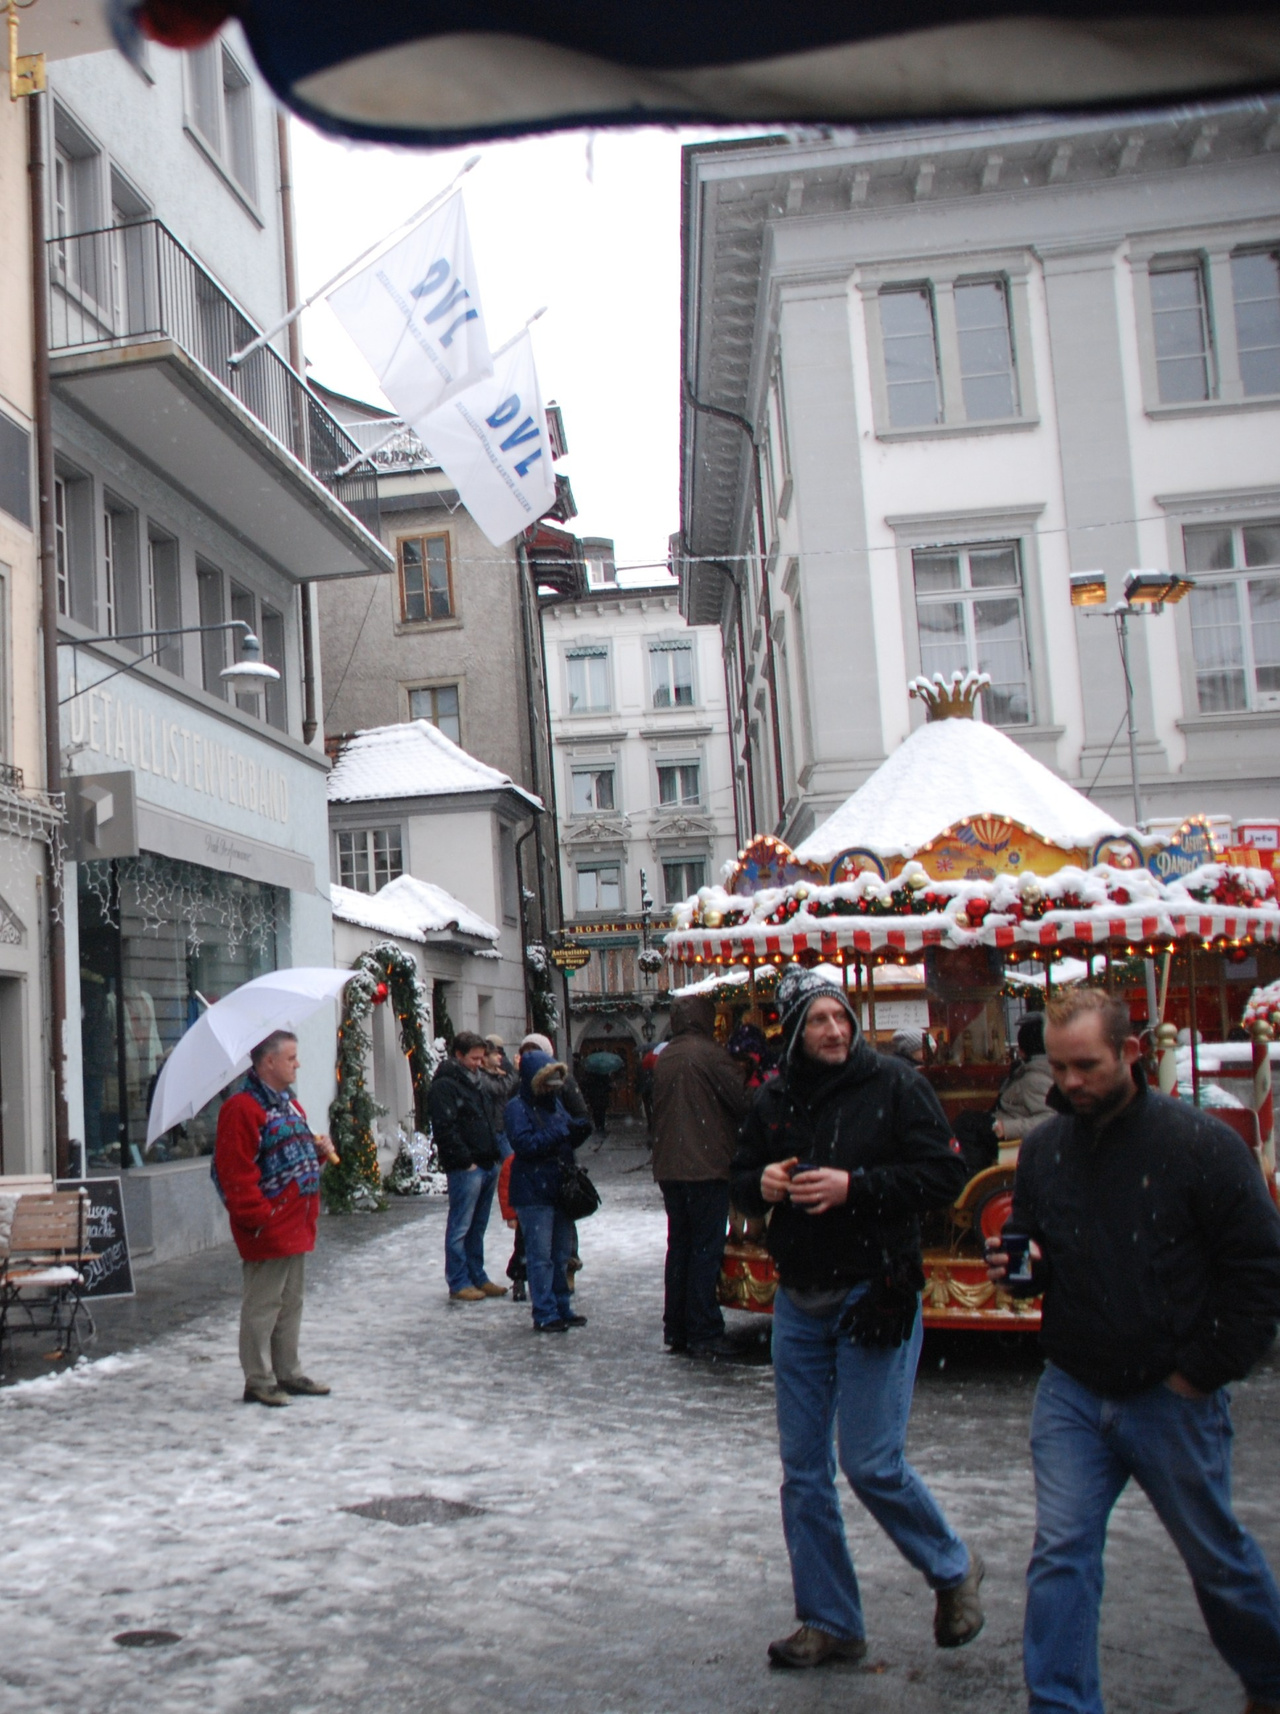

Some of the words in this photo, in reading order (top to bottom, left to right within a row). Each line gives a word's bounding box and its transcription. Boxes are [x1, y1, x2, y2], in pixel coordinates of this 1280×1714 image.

[410, 257, 478, 349] DVL
[485, 393, 542, 478] DVL
[575, 924, 619, 934] HOTEL
[625, 923, 643, 932] DU
